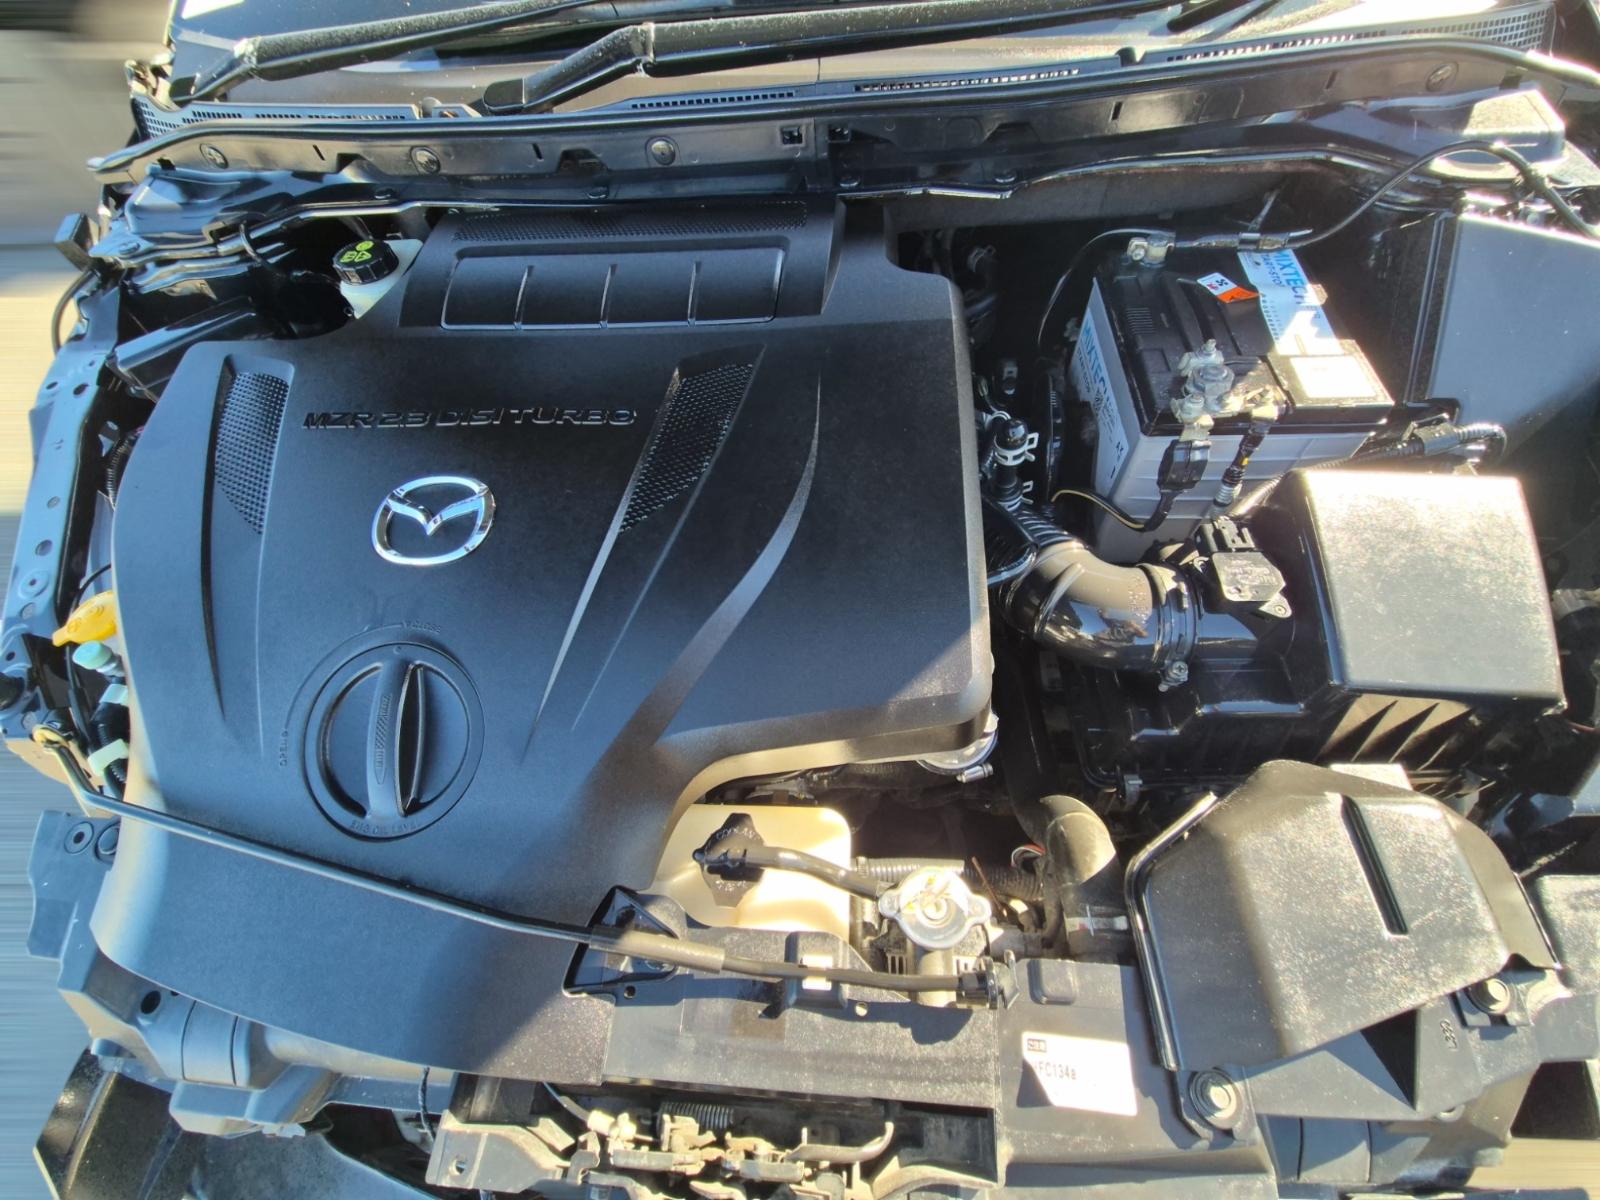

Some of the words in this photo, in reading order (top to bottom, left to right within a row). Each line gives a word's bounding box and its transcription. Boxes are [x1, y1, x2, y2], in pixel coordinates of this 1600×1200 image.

[1083, 319, 1110, 402] MIXTEC
[301, 412, 373, 429] MZR
[509, 408, 638, 426] TURBO
